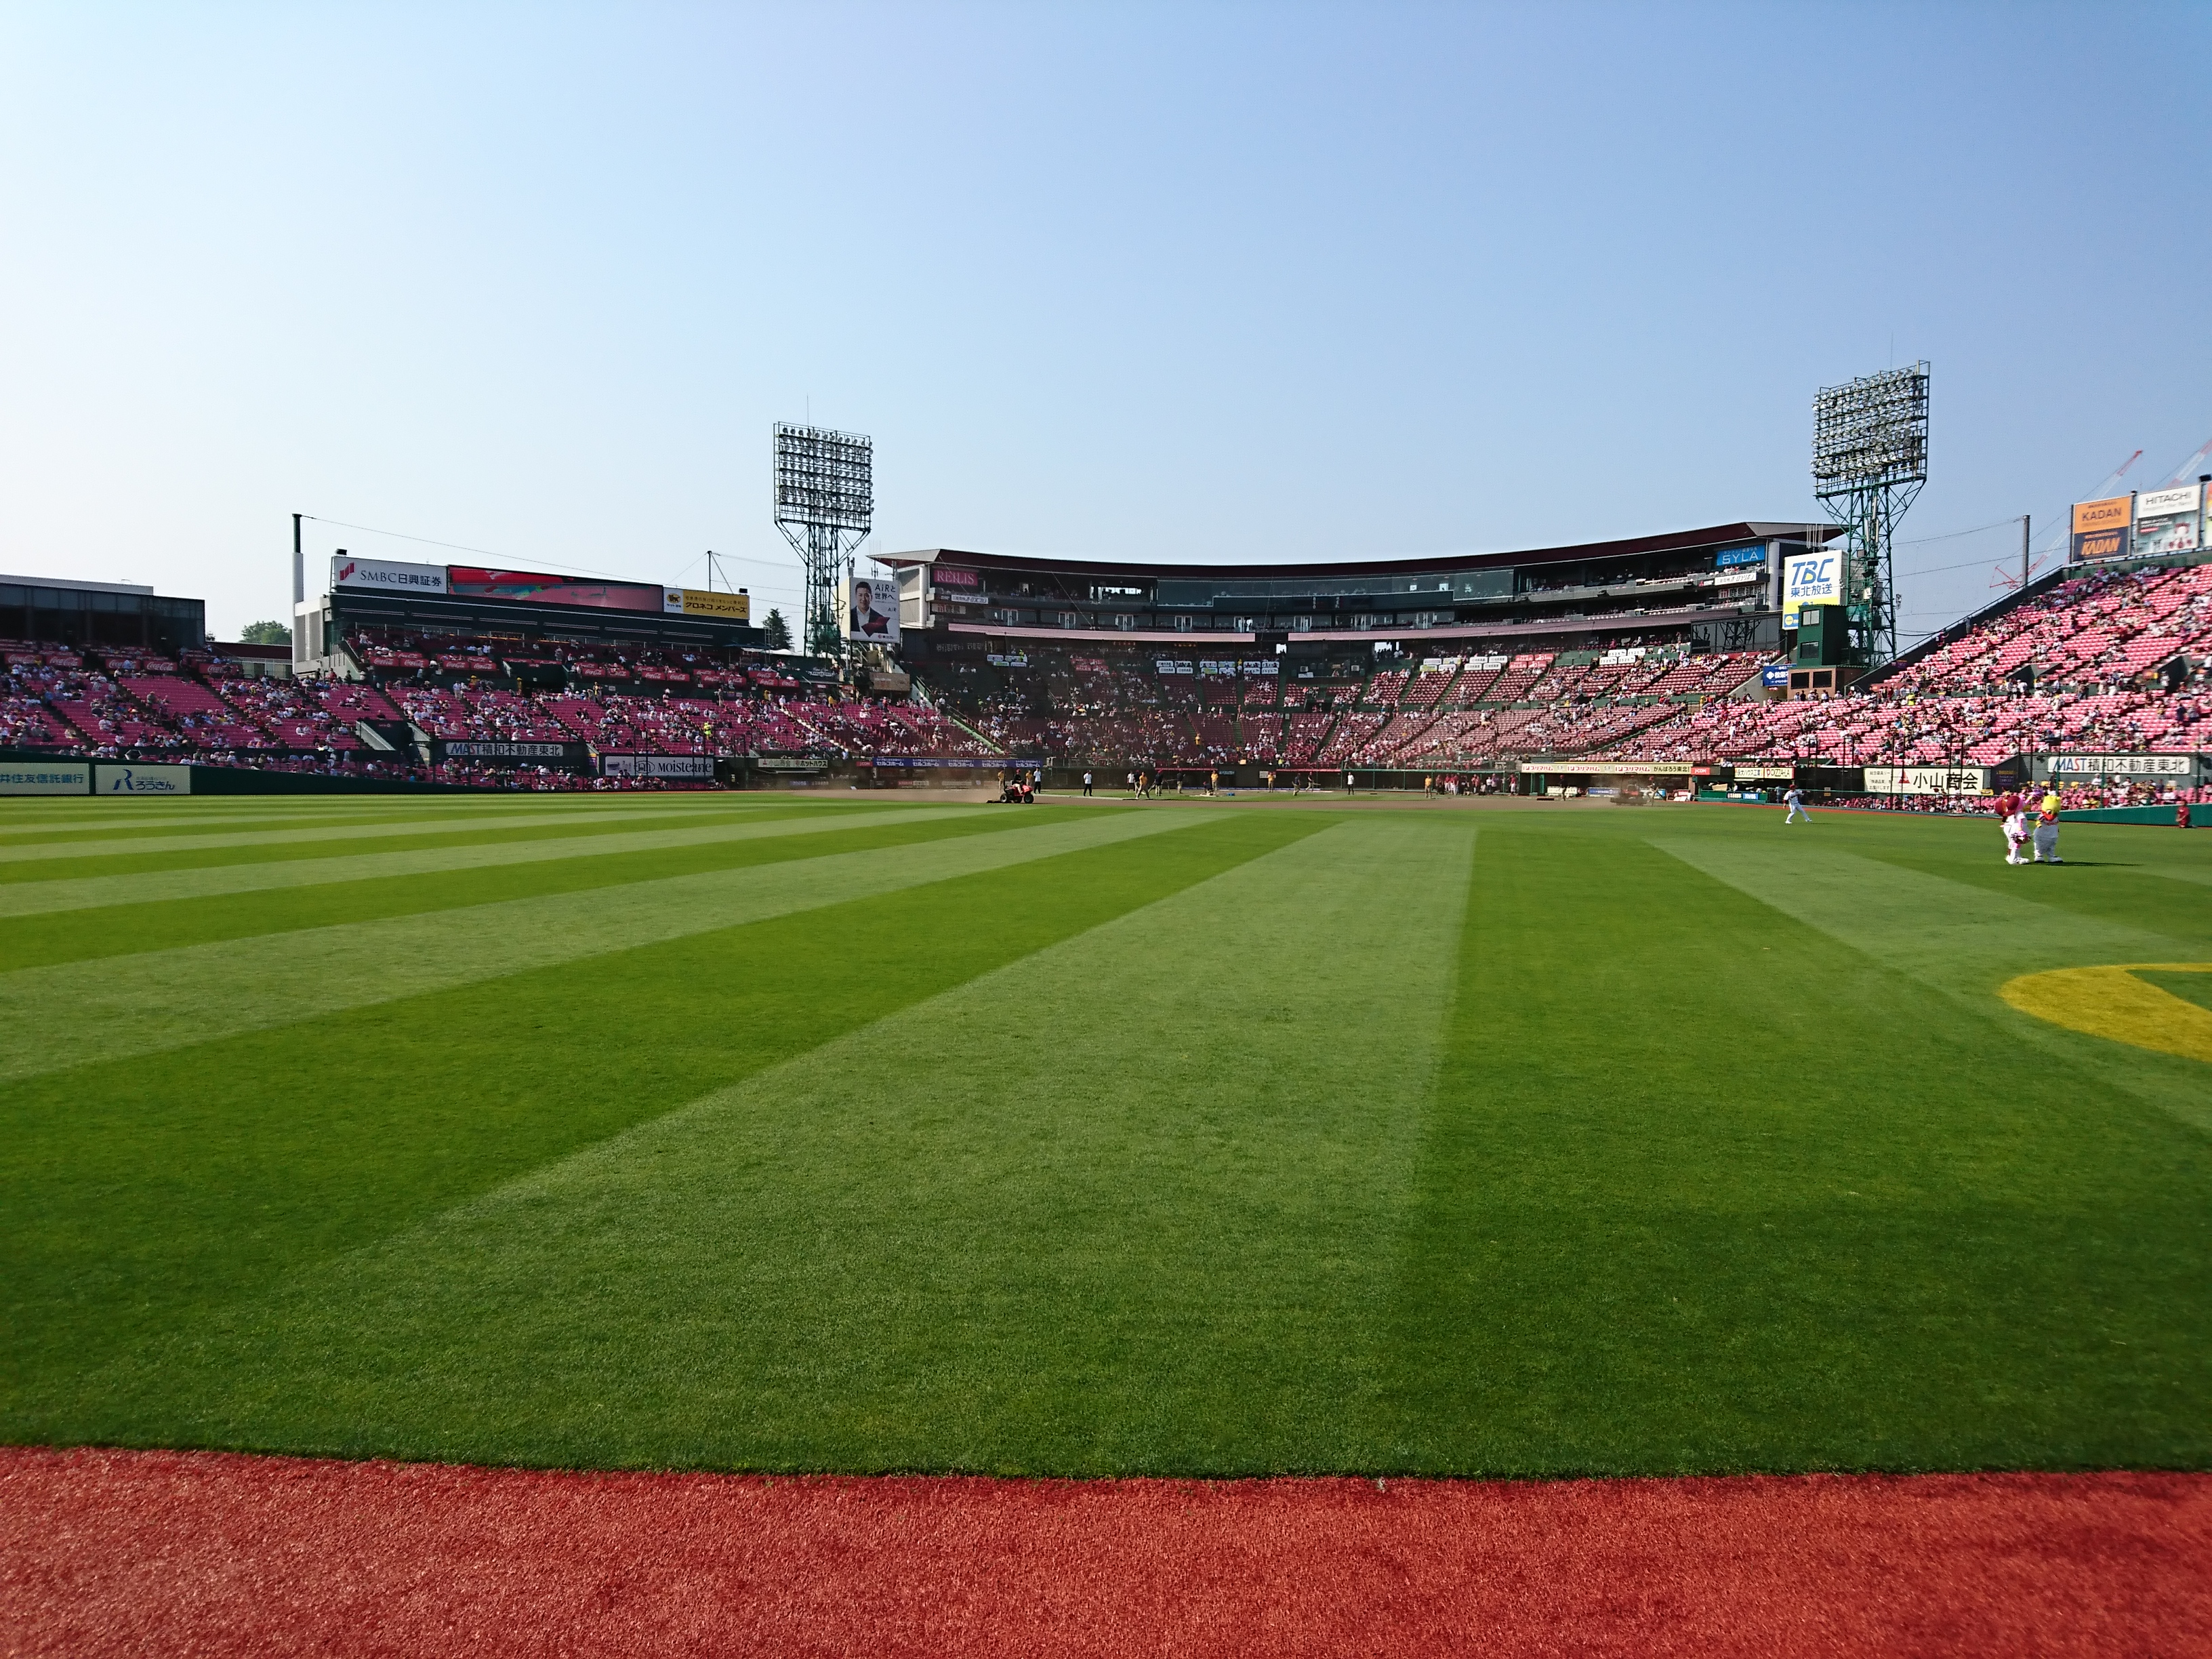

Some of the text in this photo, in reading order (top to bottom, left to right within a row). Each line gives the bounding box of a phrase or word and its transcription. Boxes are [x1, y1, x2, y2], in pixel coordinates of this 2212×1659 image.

[2146, 491, 2192, 505] HITACHI
[2082, 507, 2122, 522] KADAN
[2081, 536, 2121, 556] KADAN
[1722, 551, 1759, 565] SYLA
[360, 570, 442, 587] SMBC日興証券
[1791, 558, 1835, 586] TBC
[1790, 583, 1832, 597] 東北放送
[685, 602, 713, 610] クロネコ
[450, 743, 560, 756] MAST 積和不動産東北
[658, 760, 712, 773] Moisteane
[2053, 758, 2185, 773] MAST 積和不動産東北
[0, 773, 84, 783] 井住友信託銀行
[1913, 772, 1978, 790] 小山商会
[136, 781, 175, 791] ろうきん
